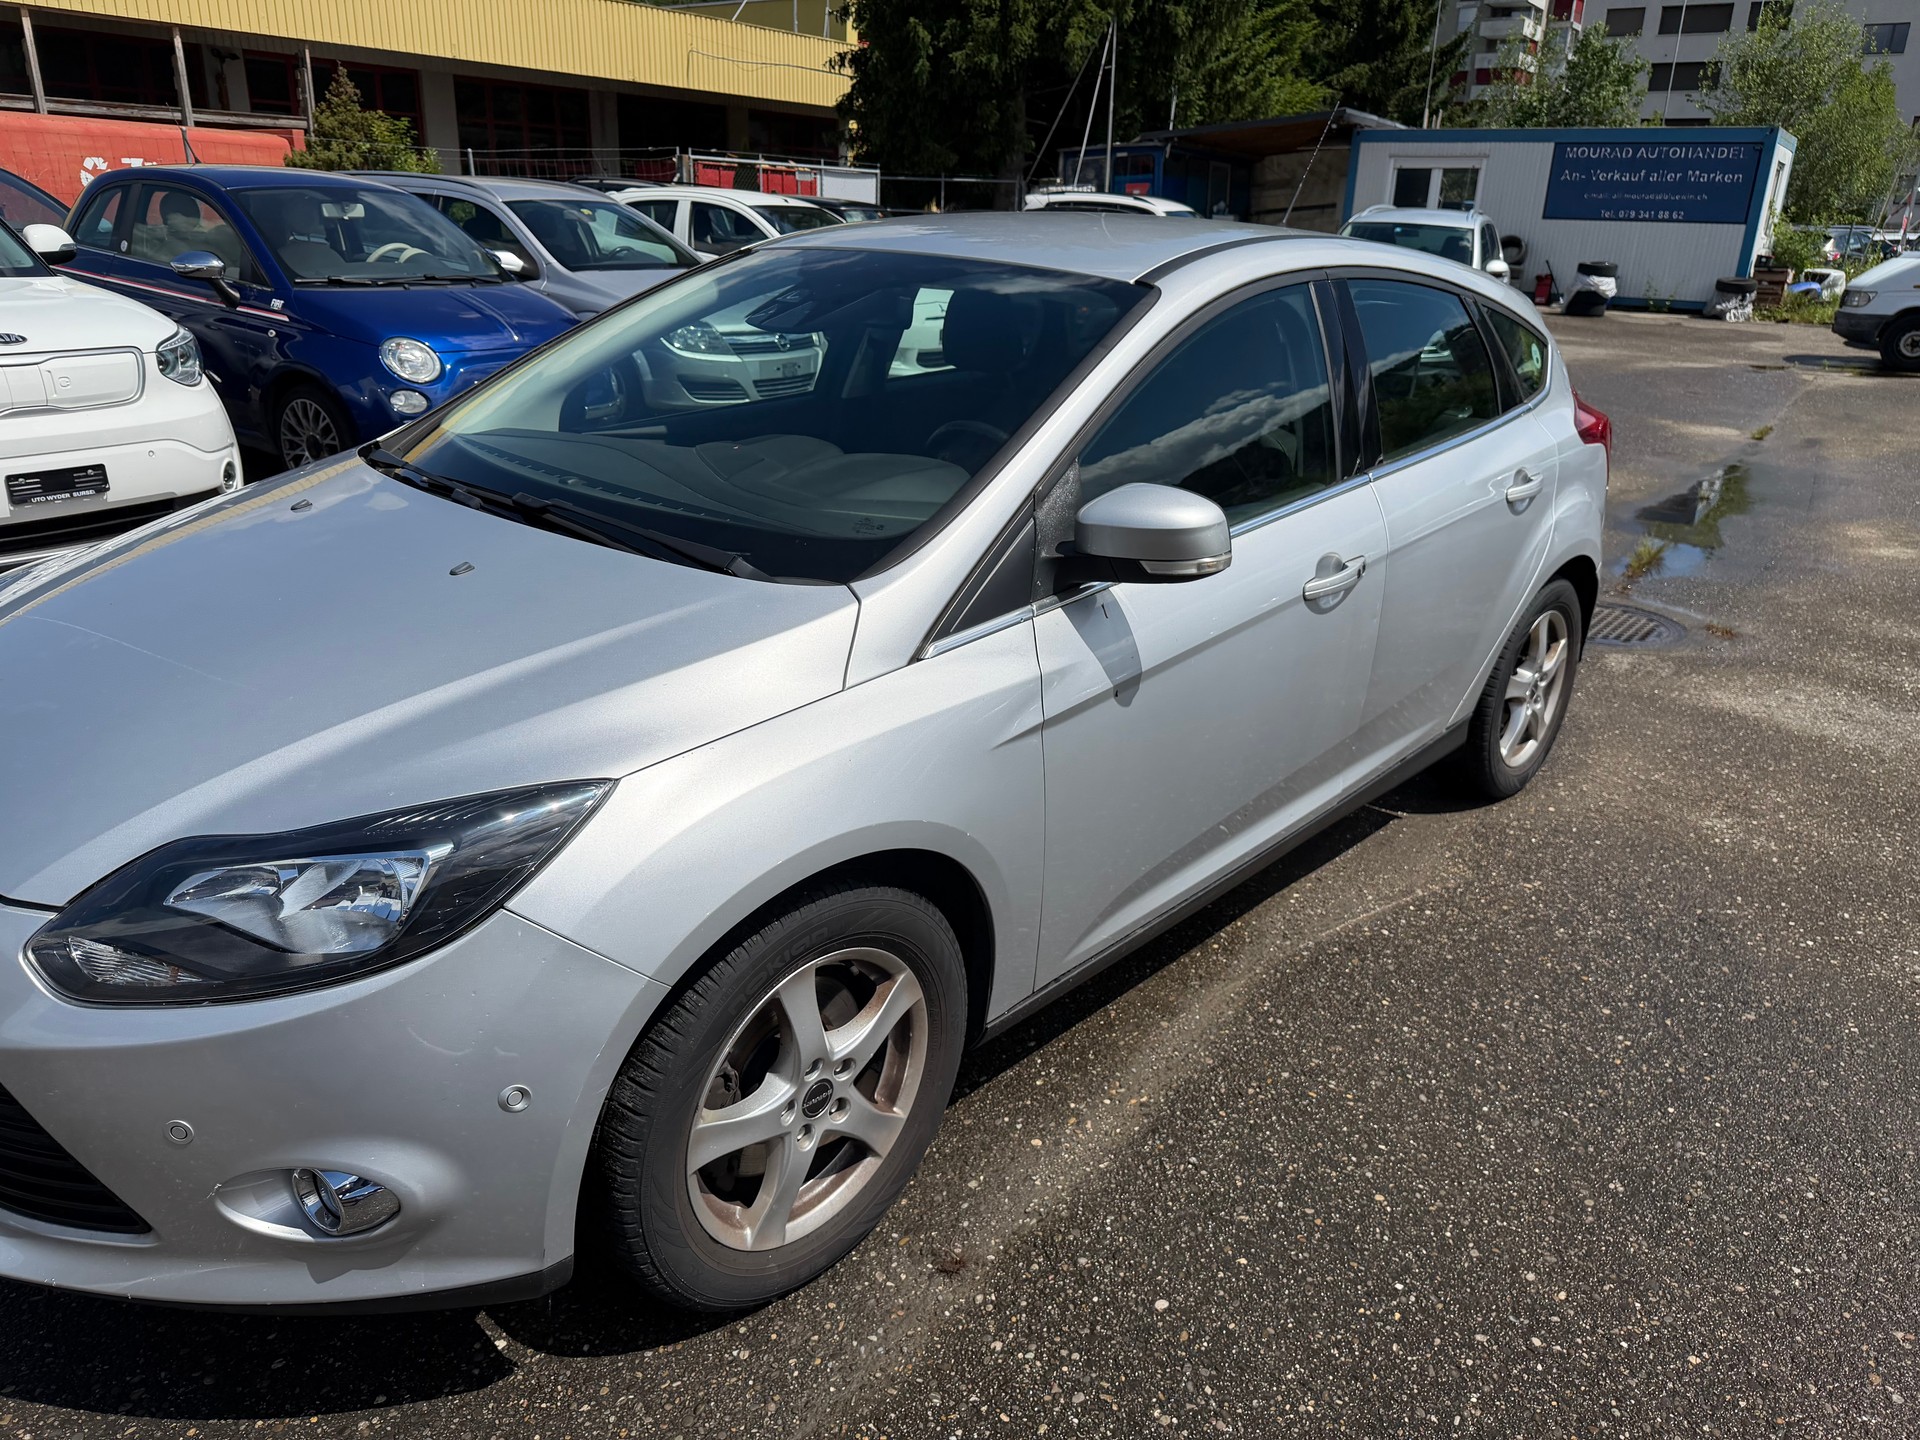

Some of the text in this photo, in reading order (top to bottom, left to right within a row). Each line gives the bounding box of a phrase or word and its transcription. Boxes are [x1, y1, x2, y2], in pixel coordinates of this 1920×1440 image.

[1565, 146, 1747, 160] MOURAD AUTOHANDEL
[1560, 169, 1743, 183] An- Verkauf aller Marken
[1618, 210, 1636, 219] 079
[1638, 210, 1655, 219] 341
[1657, 210, 1670, 219] 88
[1672, 210, 1685, 220] 62
[46, 492, 71, 501] WYDER
